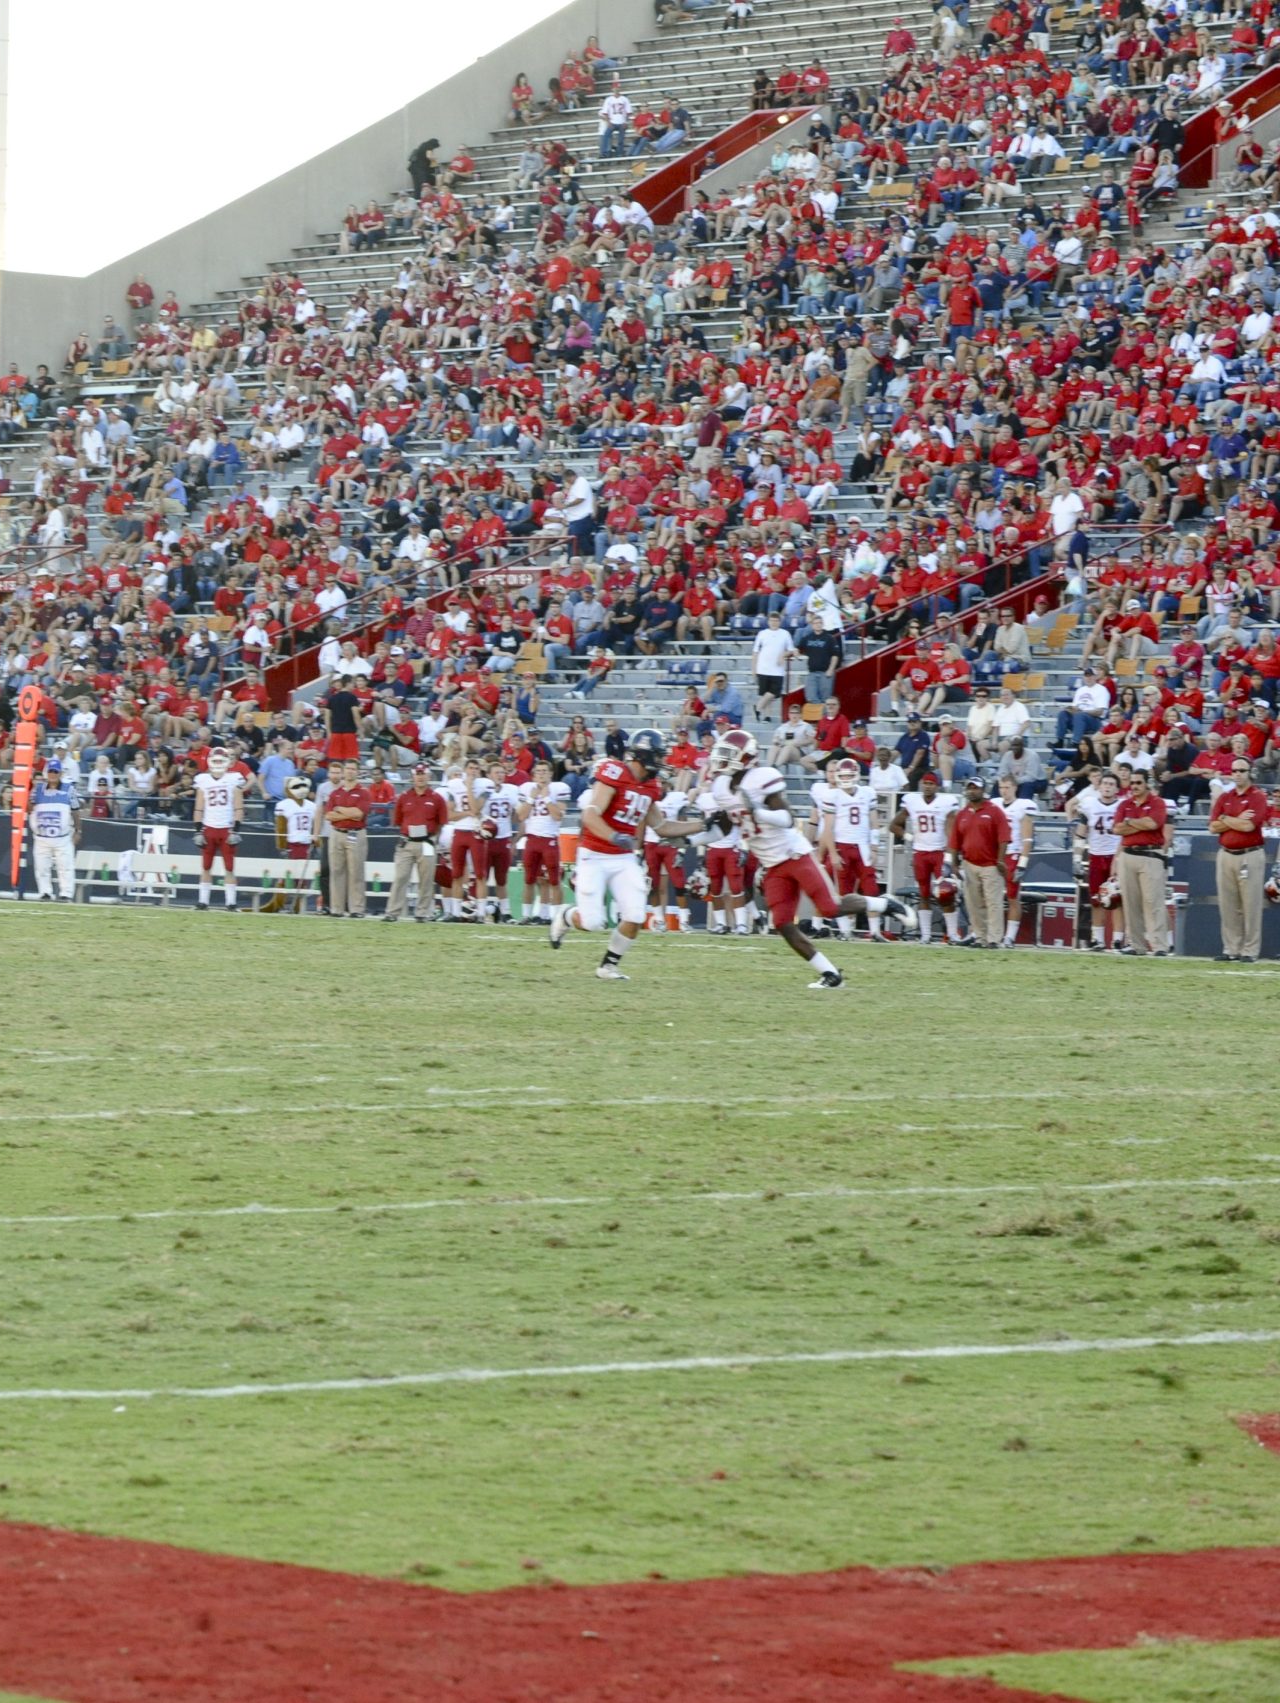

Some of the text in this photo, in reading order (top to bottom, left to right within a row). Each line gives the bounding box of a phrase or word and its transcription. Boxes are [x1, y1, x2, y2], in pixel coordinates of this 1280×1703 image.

[208, 789, 228, 807] 23
[489, 801, 511, 819] 63
[612, 790, 652, 826] 39
[849, 806, 860, 826] 8
[296, 815, 310, 831] 12
[918, 814, 937, 833] 81
